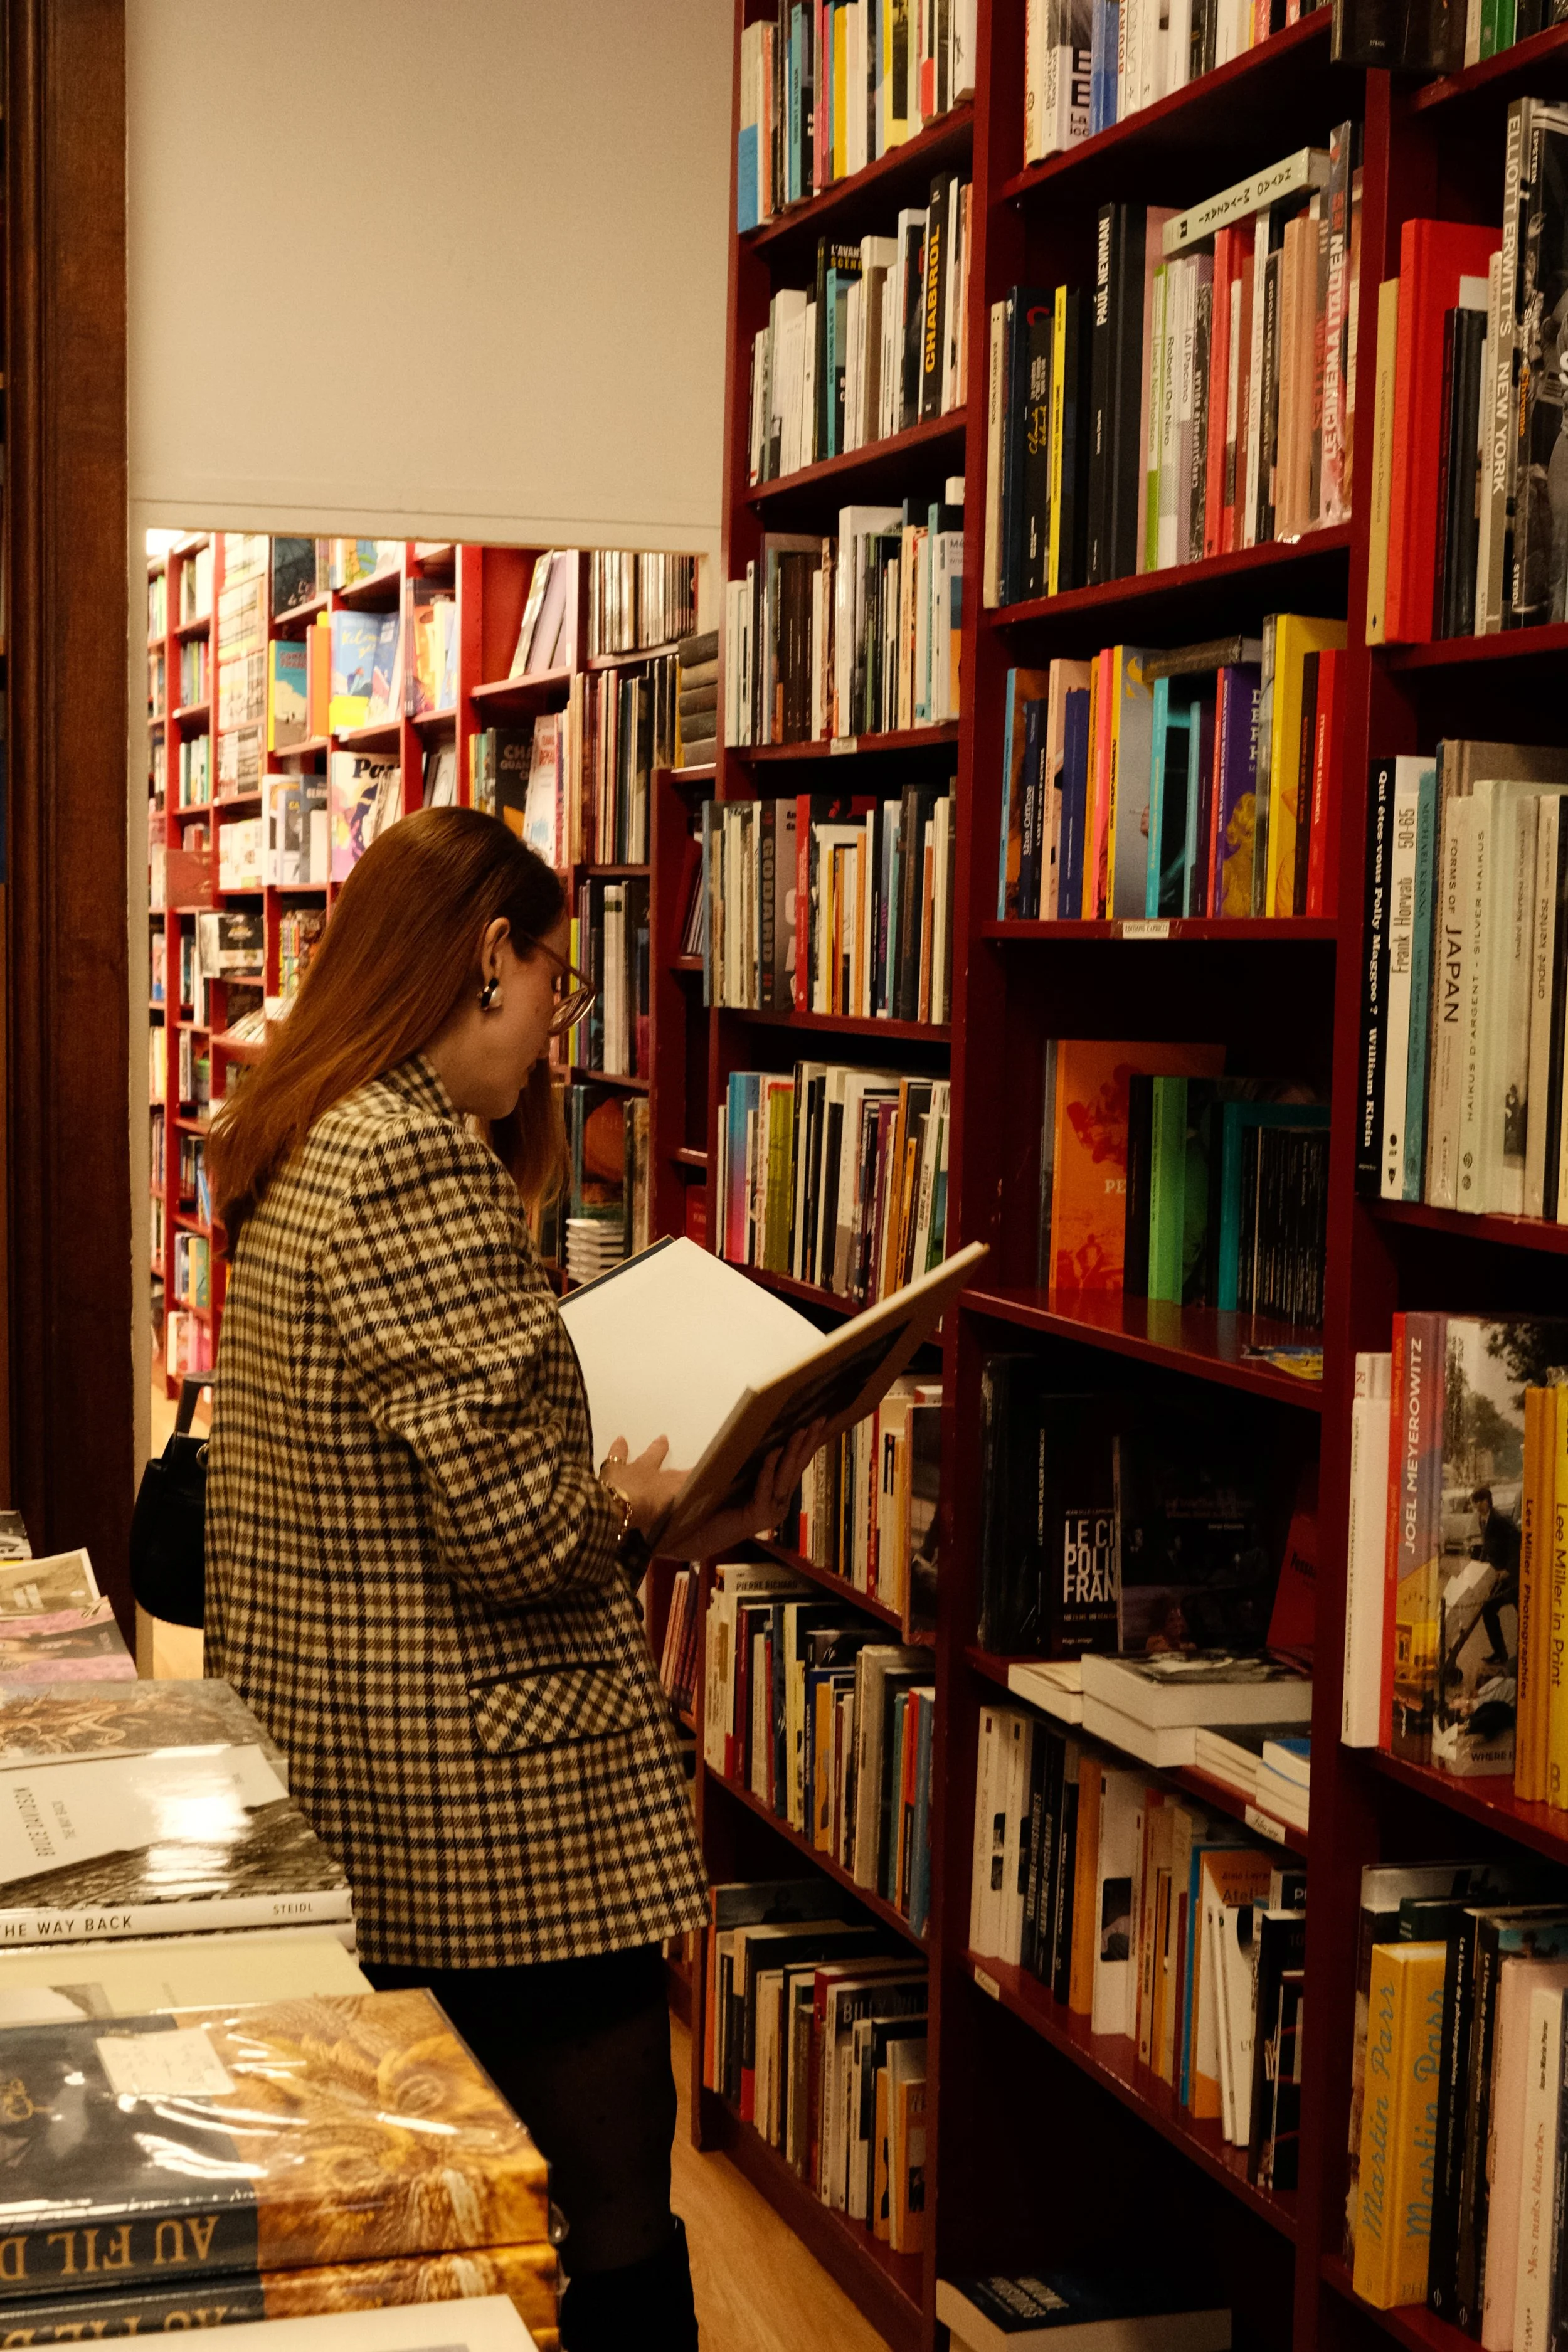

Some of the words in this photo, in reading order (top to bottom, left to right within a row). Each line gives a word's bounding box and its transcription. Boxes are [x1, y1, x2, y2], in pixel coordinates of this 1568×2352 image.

[1256, 167, 1292, 196] HAYAO
[1505, 115, 1521, 214] ELLIOTT
[1530, 129, 1539, 184] EPSTEIN
[1197, 186, 1251, 225] MIYAZAKI
[1098, 217, 1110, 285] NEWMAN
[925, 223, 940, 374] CHABROL
[1500, 220, 1517, 338] ERWITT'S
[1096, 284, 1108, 327] PAUL
[1265, 279, 1274, 359] EASTWOOD
[1166, 336, 1175, 388] Robert
[1184, 333, 1192, 346] Al
[1165, 391, 1173, 411] De
[1182, 350, 1191, 403] Pacino
[1495, 361, 1511, 420] NEW
[1164, 416, 1172, 447] Niro
[1323, 432, 1337, 461] LE
[1493, 423, 1507, 494] YORK
[1512, 563, 1520, 610] STEIDL
[1316, 712, 1325, 768] MINNELLI
[1024, 785, 1034, 829] Office
[1314, 770, 1322, 825] VINCENTE
[1379, 770, 1387, 802] Qui
[1023, 829, 1031, 855] the
[1375, 805, 1386, 883] êtes-vous
[1397, 807, 1416, 850] 50-65
[1420, 802, 1431, 864] MICHAEL
[1449, 838, 1458, 891] FORMS
[1476, 830, 1485, 891] HAIKUS
[762, 837, 775, 963] GODARD
[1372, 886, 1383, 931] Polly
[1393, 877, 1413, 928] Horvat
[1418, 869, 1428, 919] KENNA
[1448, 895, 1456, 915] OF
[1473, 898, 1482, 954] SILVER
[1391, 933, 1411, 974] Frank
[1444, 924, 1463, 1023] JAPAN
[1537, 953, 1546, 1000] andré
[1370, 1005, 1378, 1015] ?
[1469, 975, 1479, 1056] D'ARGENT
[1366, 1027, 1377, 1096] William
[1467, 1062, 1476, 1122] HAIKUS
[1364, 1100, 1375, 1147] Klein
[1407, 1337, 1422, 1492] MEYEROWITZ
[1066, 1520, 1088, 1549] LE
[1095, 1518, 1114, 1549] CI
[1404, 1498, 1417, 1554] JOEL
[1525, 1498, 1534, 1523] Lee
[1555, 1502, 1568, 1541] Lee
[1524, 1530, 1533, 1575] Miller
[1552, 1547, 1568, 1607] Miller
[1520, 1583, 1532, 1700] Photographies
[1552, 1610, 1562, 1628] in
[1551, 1638, 1565, 1688] Print
[272, 1902, 314, 1915] STEIDL
[1222, 1887, 1254, 1904] Atel
[0, 1922, 28, 1938] HE
[38, 1919, 75, 1935] WAY
[84, 1915, 132, 1932] BACK
[1362, 2095, 1389, 2240] Martin
[47, 2225, 125, 2275] FIL
[154, 2215, 221, 2265] AU
